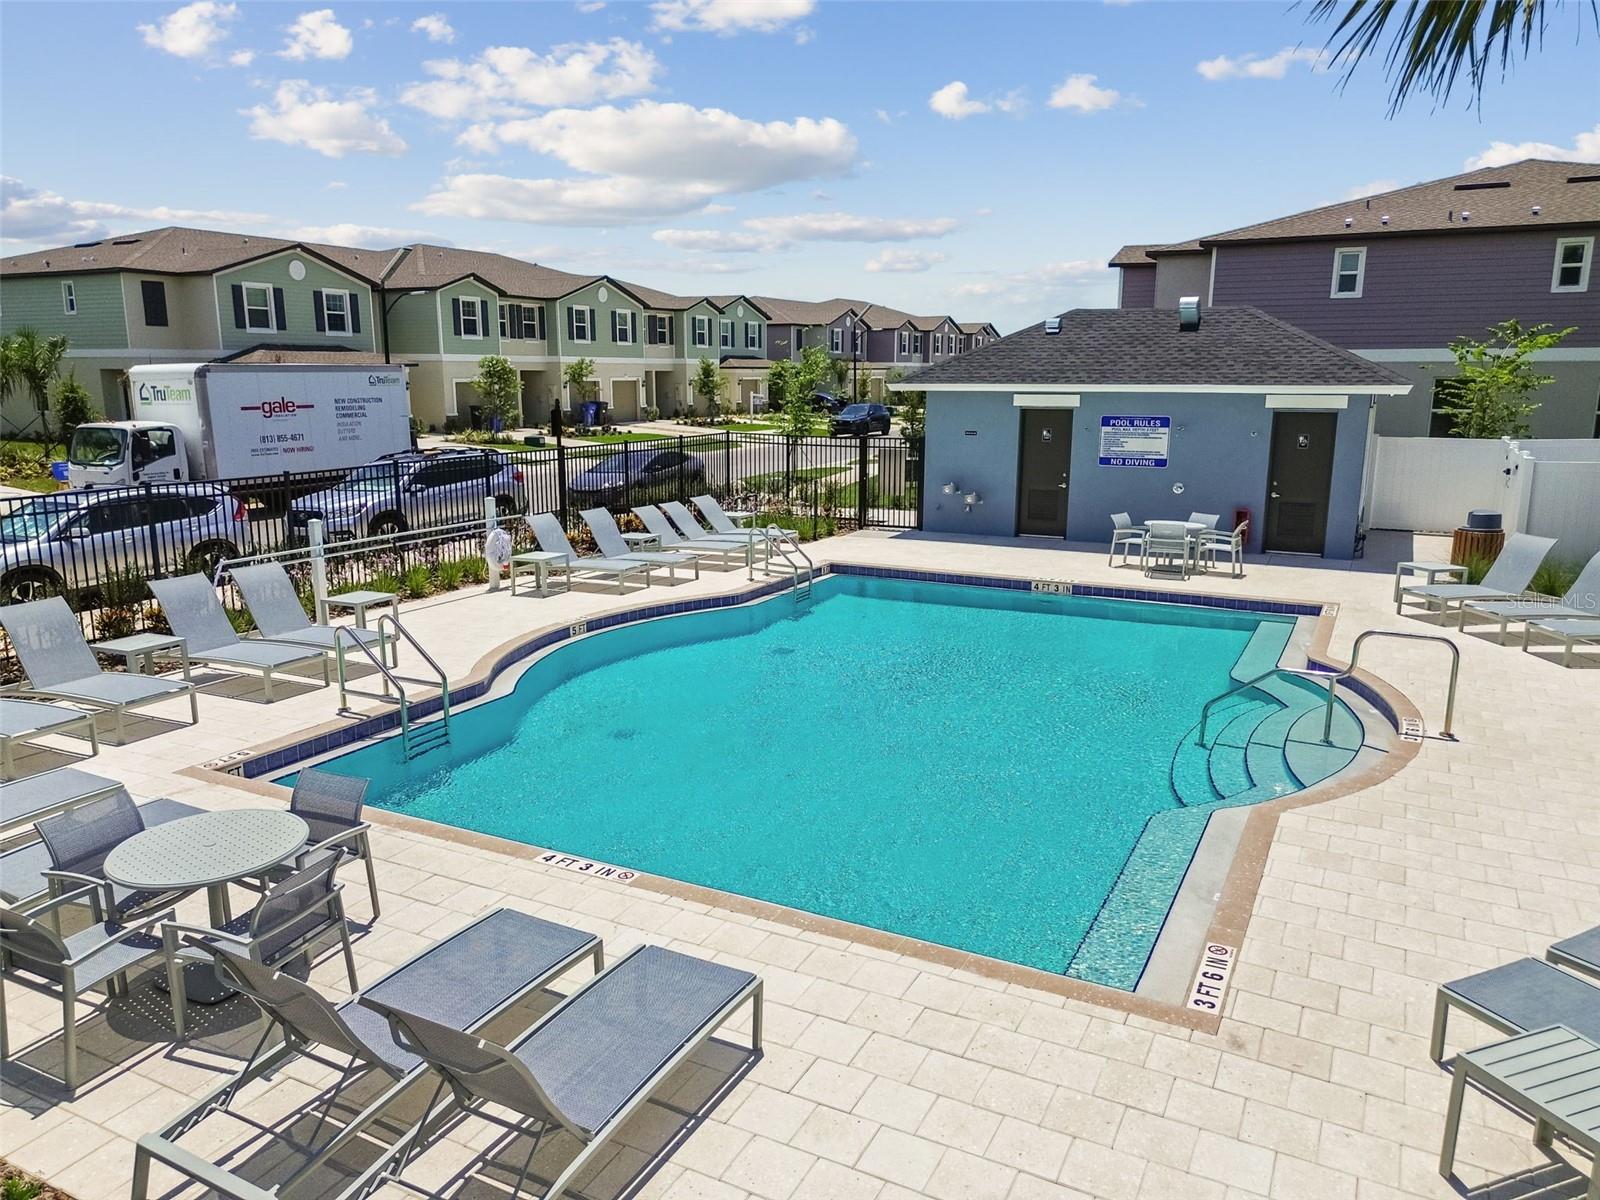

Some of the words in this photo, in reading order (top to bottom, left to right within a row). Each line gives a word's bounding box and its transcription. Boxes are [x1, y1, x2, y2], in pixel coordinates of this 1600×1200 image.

[375, 375, 400, 384] TruTeam
[150, 385, 192, 401] TruTeam
[261, 396, 296, 418] gale
[1110, 419, 1132, 427] POOL
[260, 435, 276, 444] (813)
[277, 433, 305, 443] 855-4671
[1033, 583, 1039, 591] 4
[1041, 583, 1051, 591] FT
[1054, 584, 1060, 592] 3
[1062, 585, 1071, 593] IN
[572, 626, 577, 635] 5
[578, 623, 586, 633] FT
[541, 854, 557, 862] 4
[555, 857, 580, 867] FT
[578, 863, 594, 871] 3
[594, 866, 617, 877] IN
[1205, 956, 1229, 971] IN
[1201, 971, 1224, 981] 6
[1196, 981, 1222, 999] FT
[1193, 998, 1216, 1010] 3
